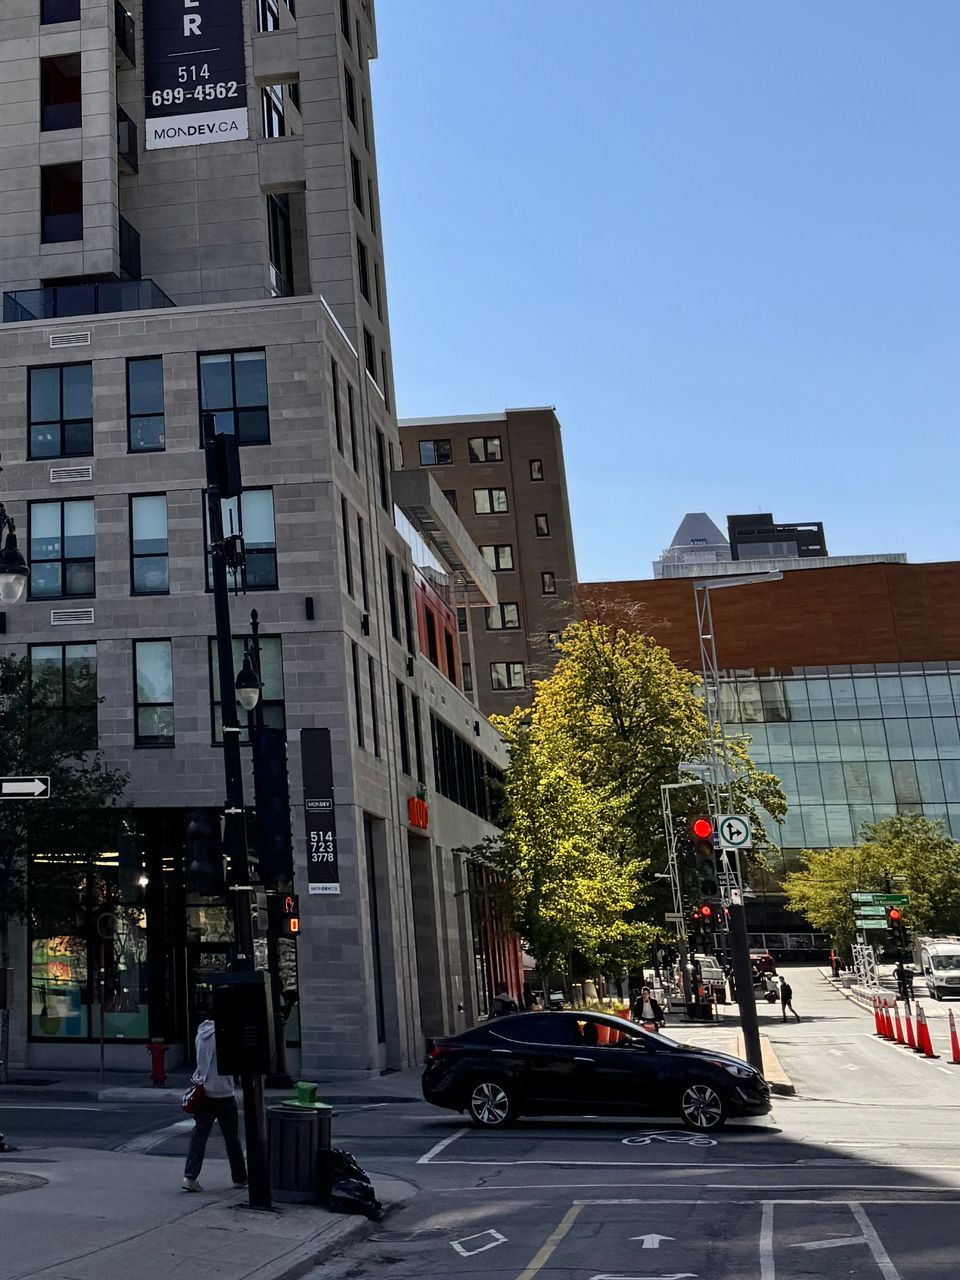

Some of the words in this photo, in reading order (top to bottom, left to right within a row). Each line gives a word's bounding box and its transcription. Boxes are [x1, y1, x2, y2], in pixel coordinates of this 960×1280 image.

[178, 63, 210, 83] 514
[152, 81, 238, 106] 699-4562
[154, 121, 238, 139] MONDEV.CA
[310, 831, 333, 841] 514
[310, 842, 333, 852] 723
[311, 853, 334, 862] 3778
